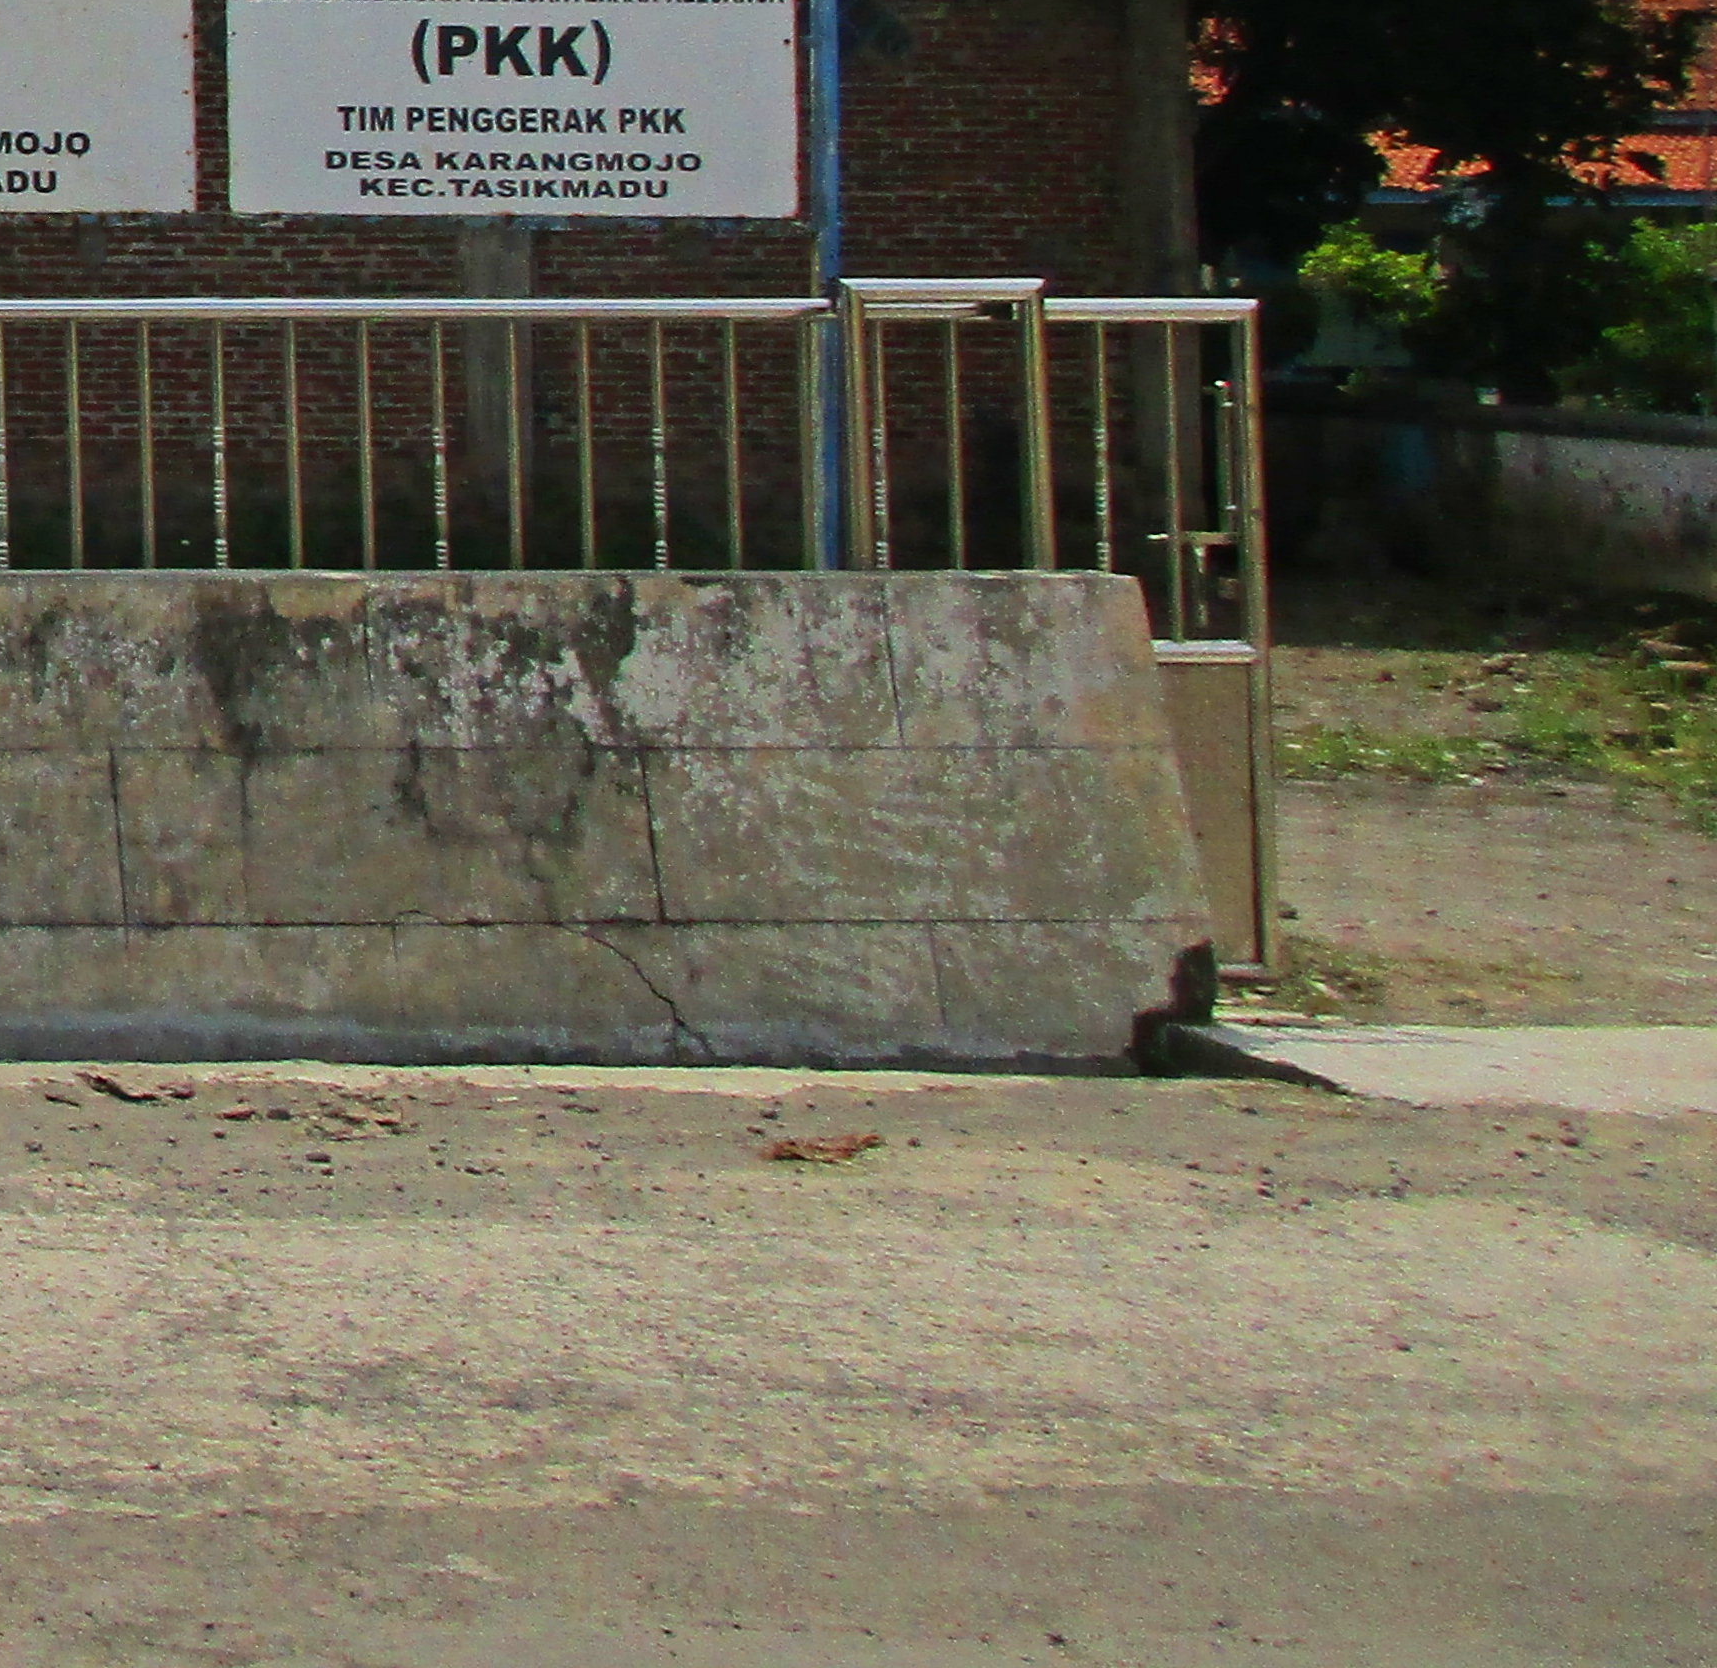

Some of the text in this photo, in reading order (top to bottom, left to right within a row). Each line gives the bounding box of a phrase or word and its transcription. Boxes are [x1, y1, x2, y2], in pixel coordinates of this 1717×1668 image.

[411, 18, 612, 86] (PKK)
[336, 105, 686, 135] TIM PENGGERAK PKK
[324, 150, 703, 173] DESA KARANGMOJO
